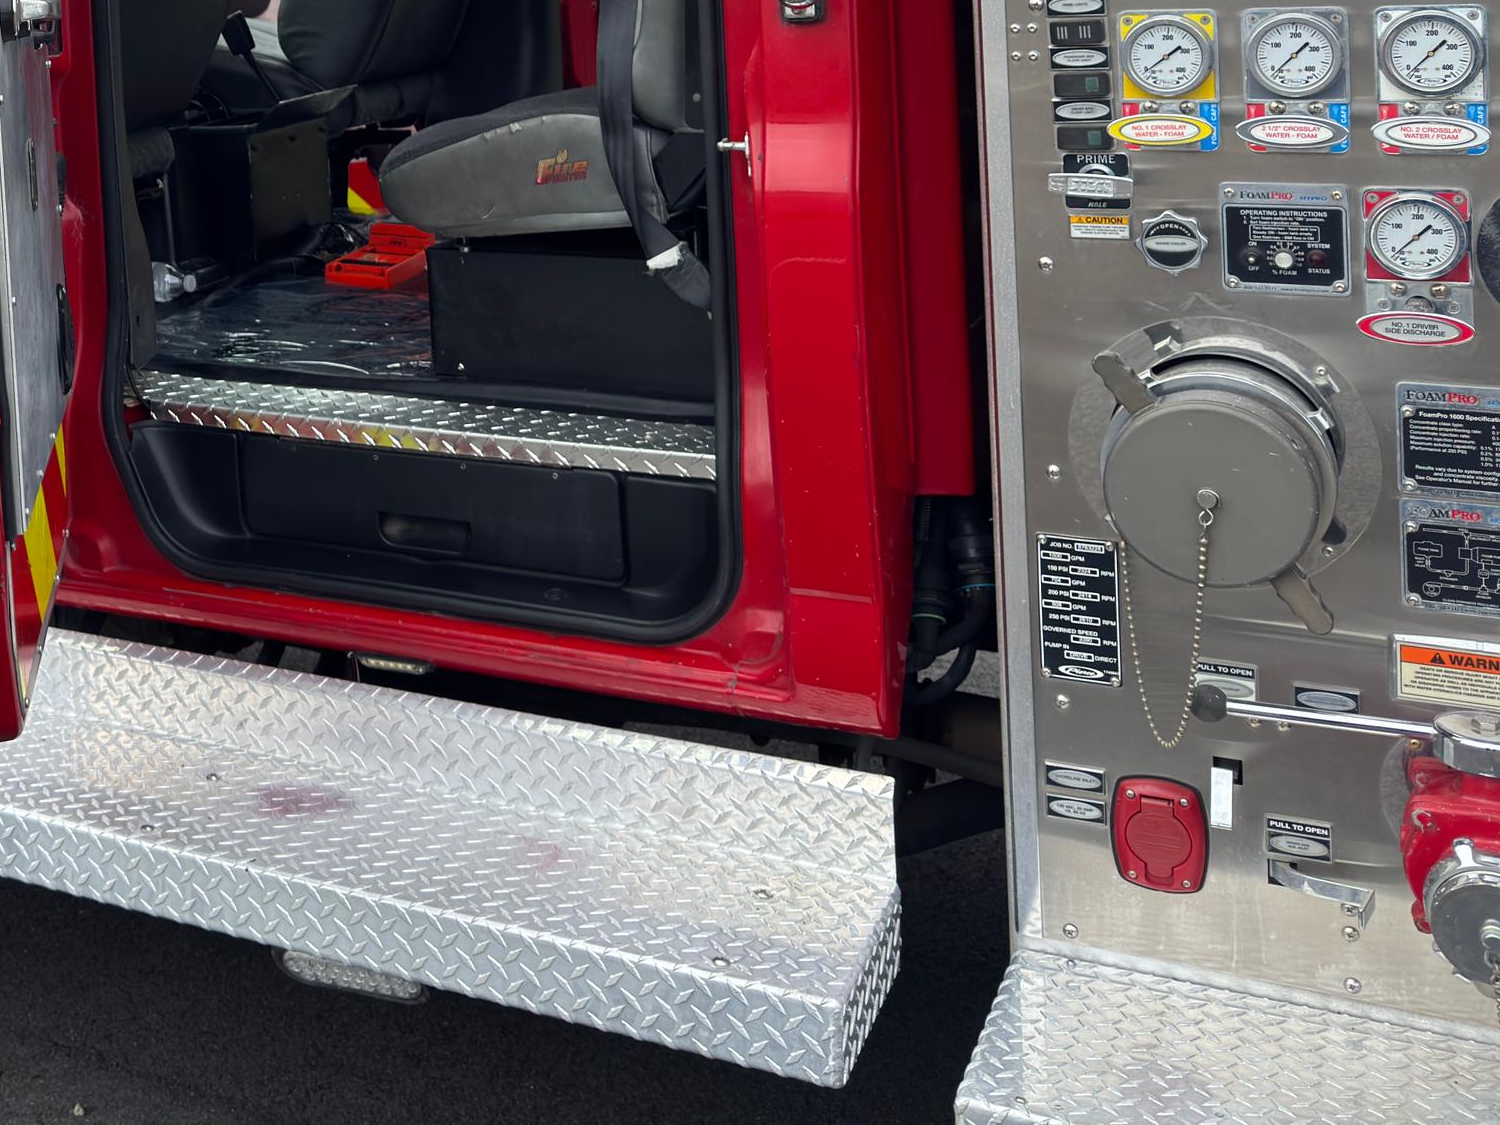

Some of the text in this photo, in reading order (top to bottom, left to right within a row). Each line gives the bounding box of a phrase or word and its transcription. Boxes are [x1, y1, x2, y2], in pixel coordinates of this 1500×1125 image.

[1077, 154, 1116, 164] PRIME
[1086, 216, 1123, 224] CAUTION
[1403, 328, 1446, 337] DISCHARGE
[1419, 411, 1448, 419] FoamPro
[1043, 626, 1098, 637] GOVERNED SPEED
[1230, 668, 1252, 676] OPEN
[1269, 820, 1291, 829] PULL
[1305, 826, 1329, 835] OPEN
